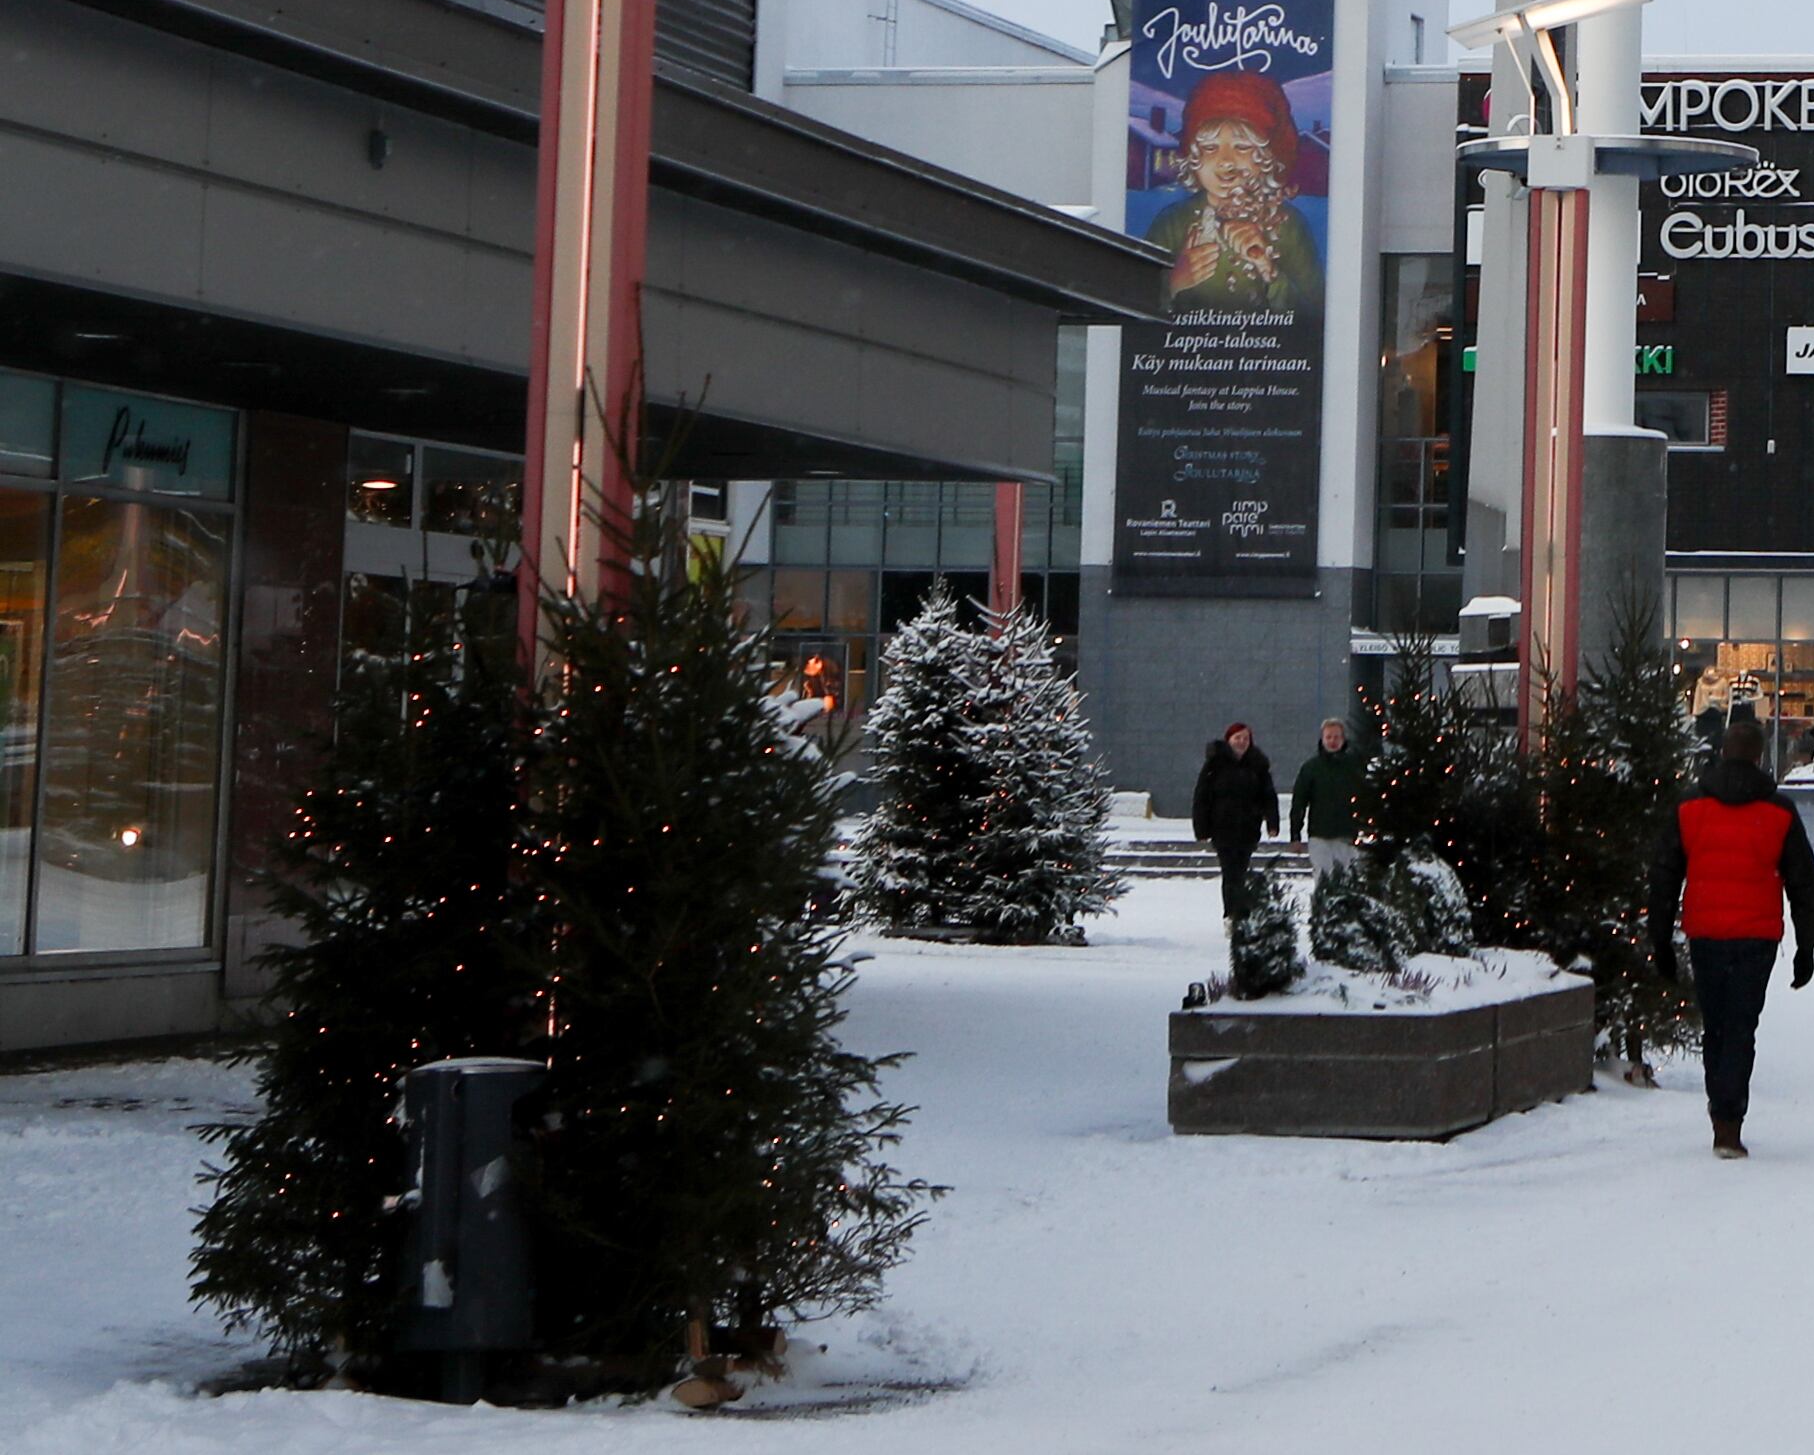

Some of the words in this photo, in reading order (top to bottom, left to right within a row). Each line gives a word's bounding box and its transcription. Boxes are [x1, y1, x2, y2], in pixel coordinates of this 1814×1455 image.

[1143, 2, 1319, 79] Joulutarina
[1168, 309, 1294, 330] usiikkinäytelmä
[1164, 332, 1281, 353] Lappia-talossa.
[1132, 354, 1165, 375] Käy
[1168, 354, 1234, 371] mukaan
[1239, 355, 1312, 372] tarinaan.
[1142, 385, 1181, 395] Musical
[1182, 385, 1218, 399] fantasy
[1219, 387, 1229, 395] at
[1231, 386, 1264, 399] Lappia
[1188, 401, 1207, 412] Join
[1210, 400, 1225, 410] the
[1126, 519, 1178, 529] Rovaniemen
[1179, 519, 1211, 529] Teatteri
